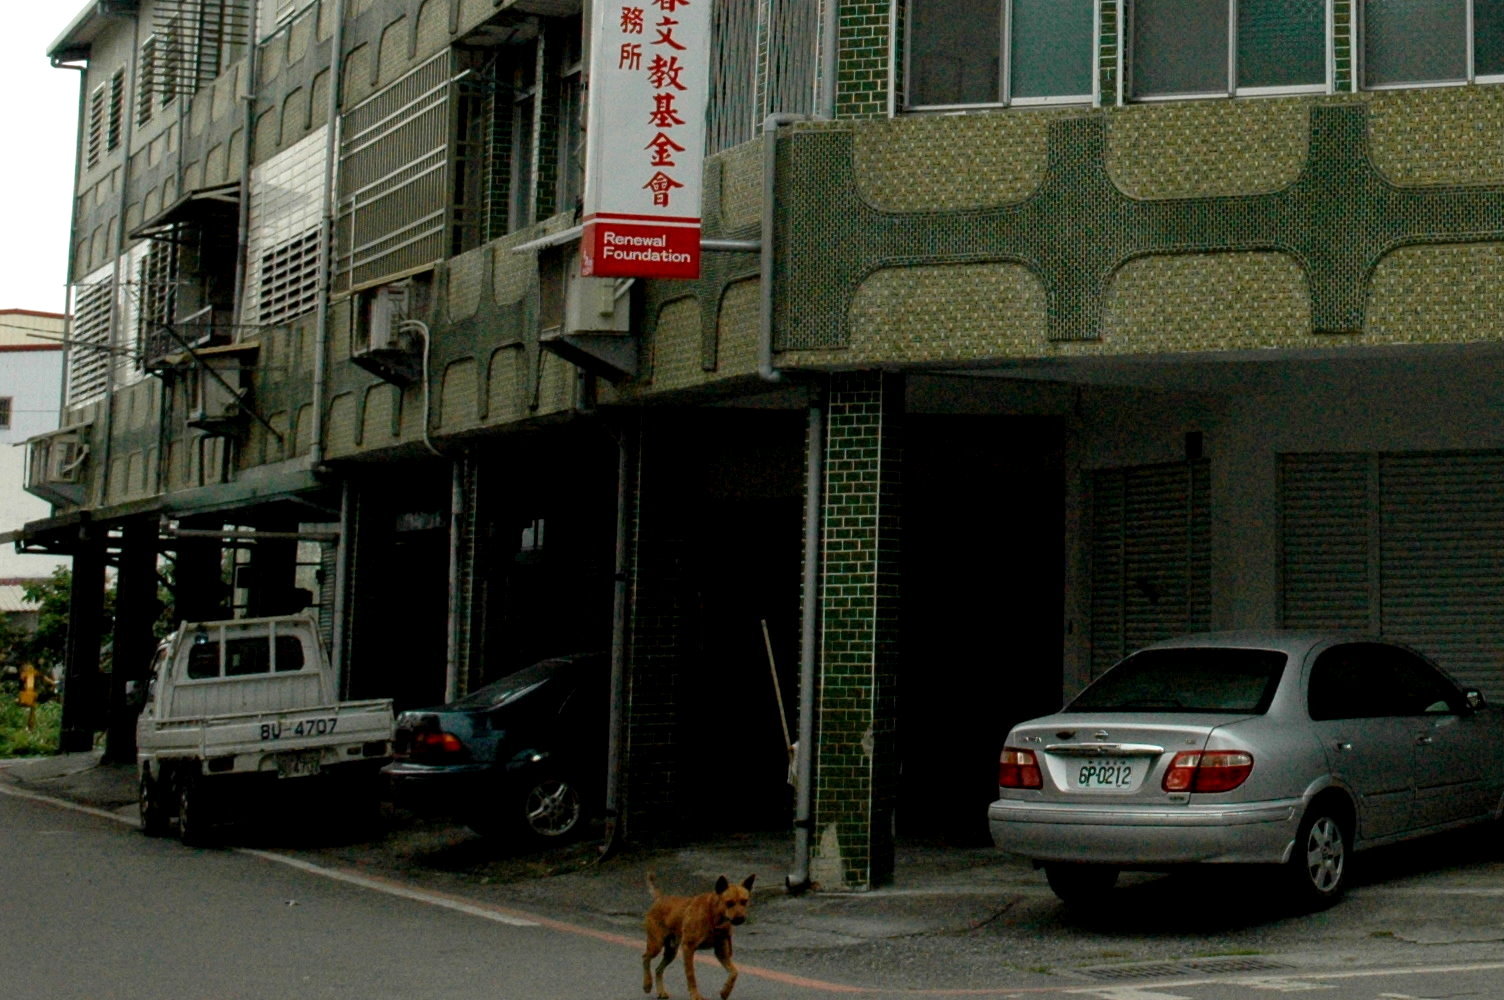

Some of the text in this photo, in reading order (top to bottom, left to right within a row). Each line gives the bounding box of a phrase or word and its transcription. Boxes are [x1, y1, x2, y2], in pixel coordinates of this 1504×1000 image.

[603, 231, 666, 248] Renewal
[603, 246, 691, 263] Foundation
[1078, 766, 1132, 786] 6P-0212
